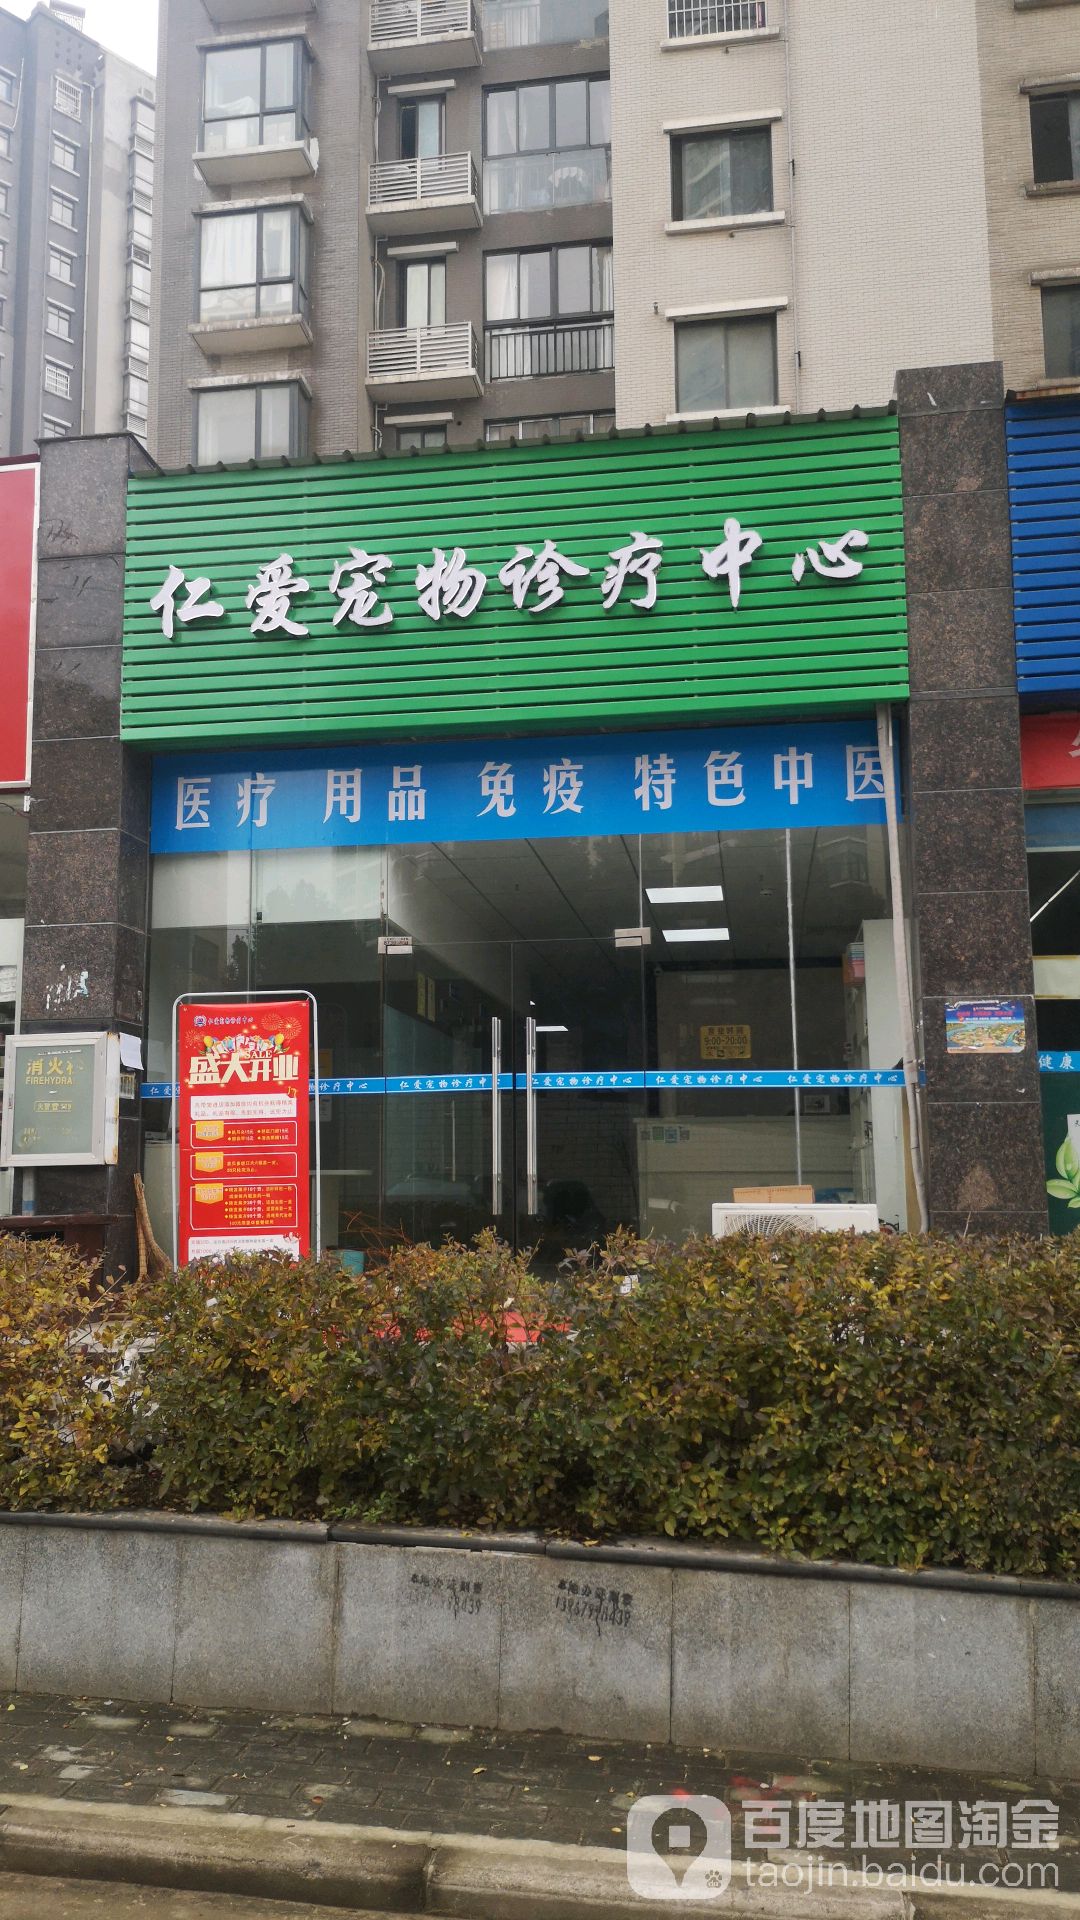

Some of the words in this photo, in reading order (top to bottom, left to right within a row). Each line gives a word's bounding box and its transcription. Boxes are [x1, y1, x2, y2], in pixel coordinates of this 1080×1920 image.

[150, 517, 869, 639] 仁爱宠物诊疗中心
[175, 772, 275, 831] 医疗
[323, 764, 427, 824] 用品
[476, 757, 584, 817] 免疫
[634, 745, 885, 812] 特色中医
[244, 1050, 273, 1059] SALE
[1039, 1053, 1074, 1070] 健康
[188, 1051, 299, 1085] 盛大开业
[400, 1077, 500, 1090] 仁爱宠物诊疗中
[655, 1073, 763, 1085] 仁爱宠物诊疗中心
[787, 1072, 898, 1084] 仁爱宠物诊疗中心
